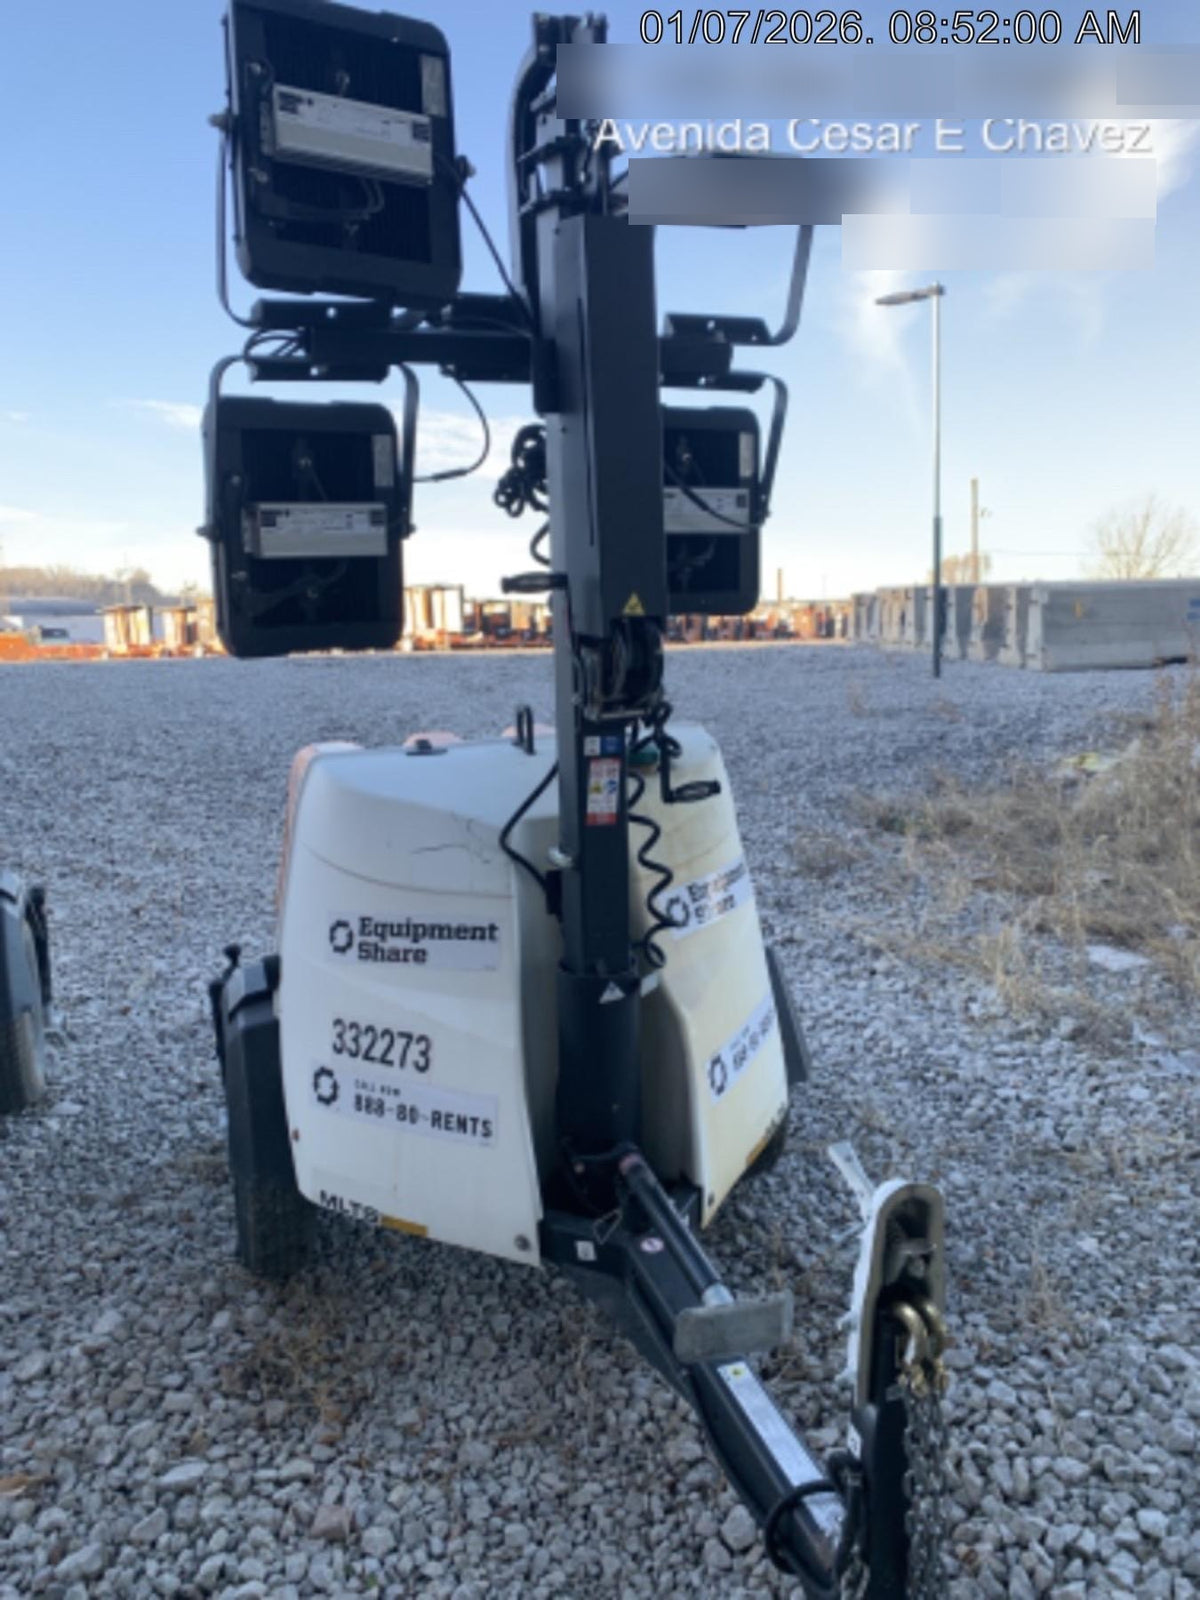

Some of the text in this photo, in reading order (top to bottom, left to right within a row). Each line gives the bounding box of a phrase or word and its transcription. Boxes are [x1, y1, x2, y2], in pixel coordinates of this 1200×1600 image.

[357, 916, 499, 943] Equipment
[357, 941, 428, 964] Share
[332, 1018, 433, 1073] 332273
